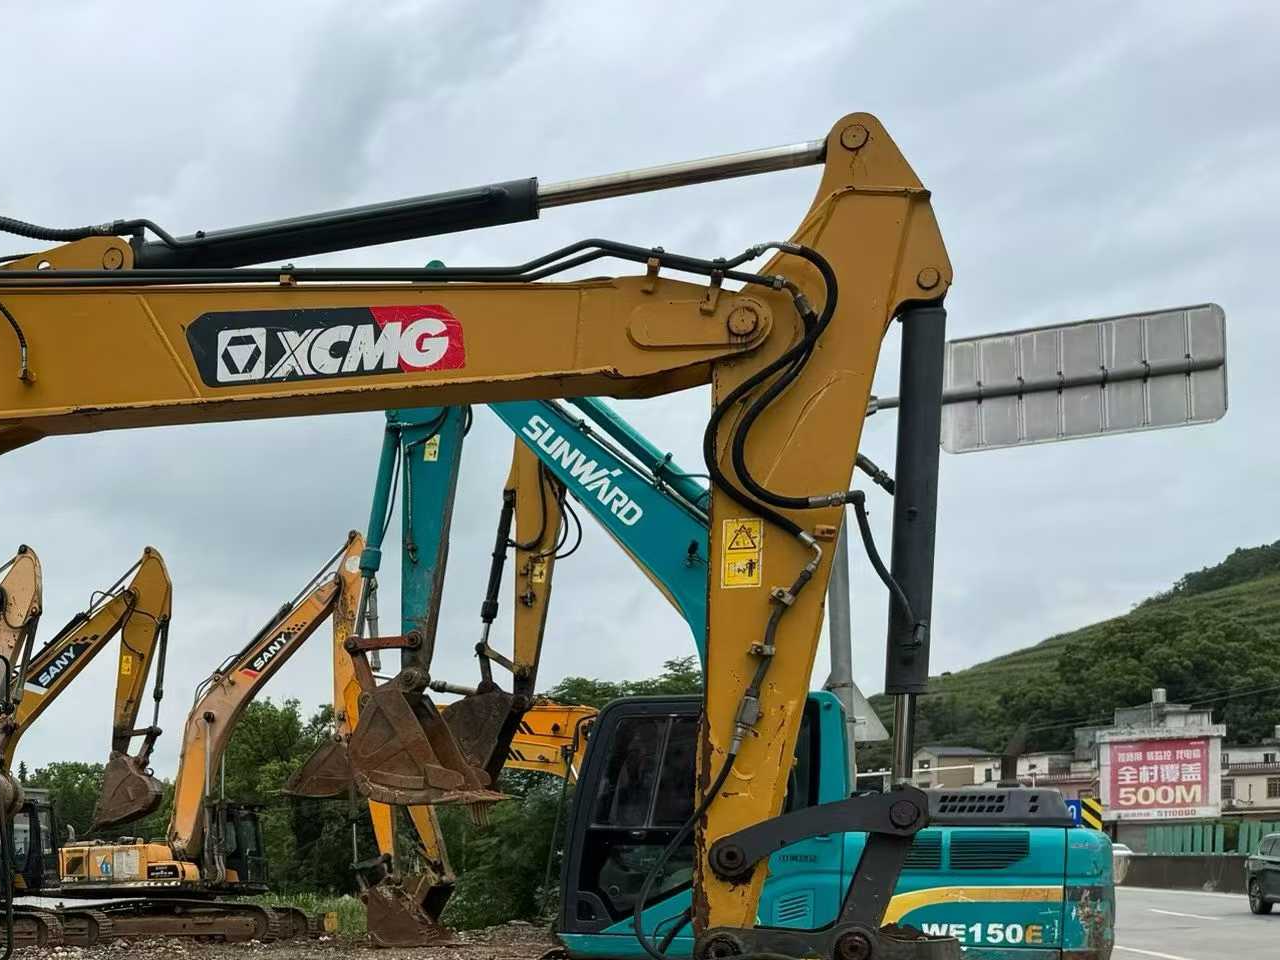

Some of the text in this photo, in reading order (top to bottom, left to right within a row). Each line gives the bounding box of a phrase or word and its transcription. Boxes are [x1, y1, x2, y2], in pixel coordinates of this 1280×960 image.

[264, 318, 449, 378] XCMG
[521, 415, 643, 526] SUNWARD
[38, 646, 75, 687] SANY
[253, 633, 287, 670] SANY
[1118, 784, 1201, 806] 500M
[922, 923, 1043, 944] WE150E
